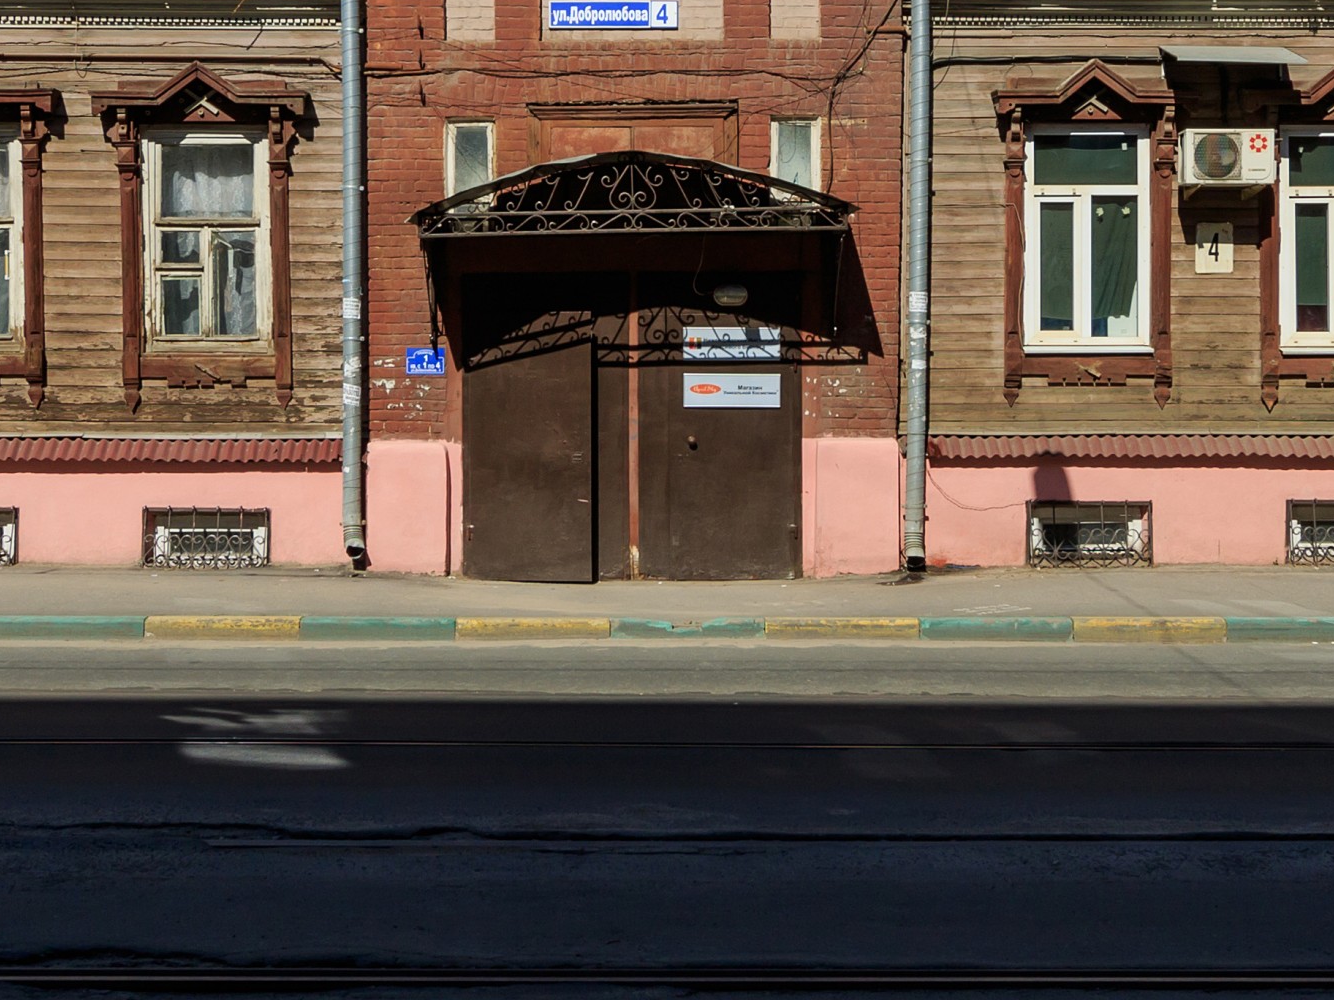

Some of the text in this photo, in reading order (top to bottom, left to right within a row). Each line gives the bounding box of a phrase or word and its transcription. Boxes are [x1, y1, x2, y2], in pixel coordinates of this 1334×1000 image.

[552, 3, 669, 25] ул.Добролюбова 4
[1208, 232, 1220, 262] 4
